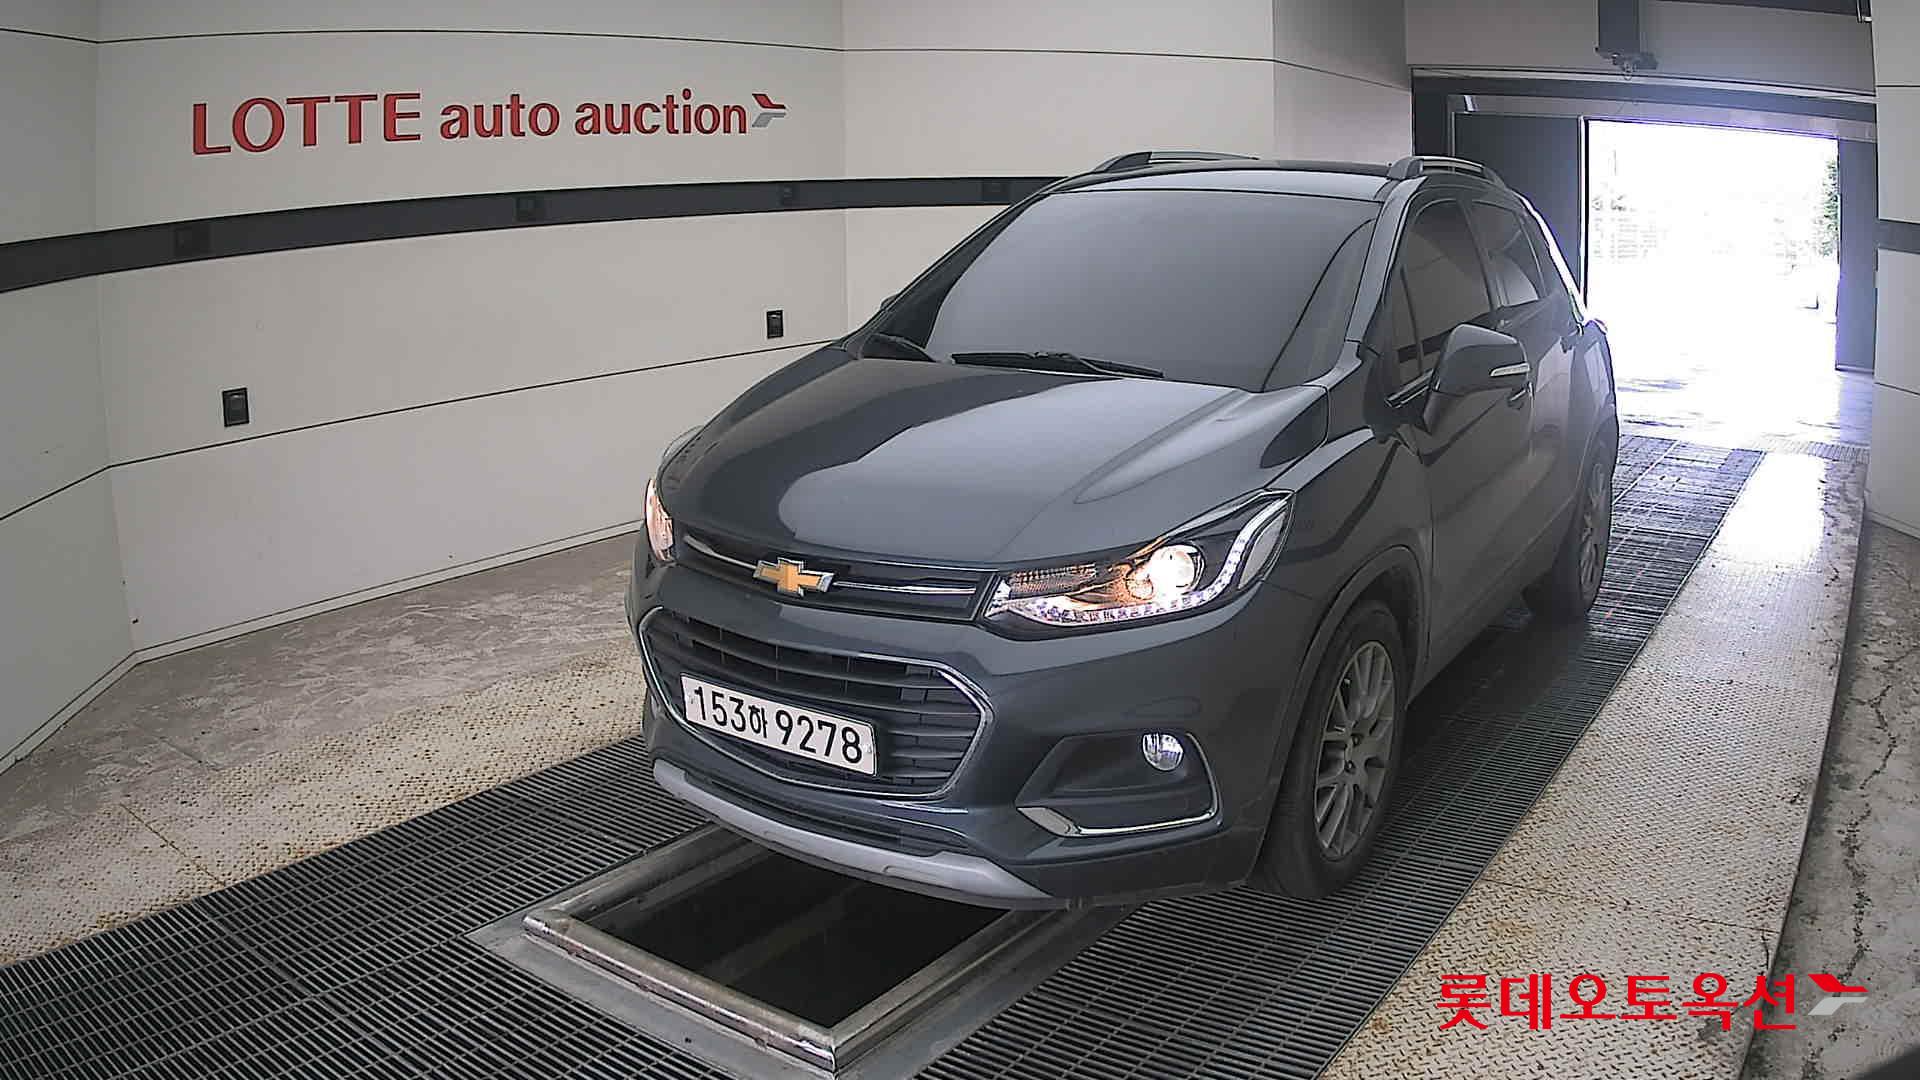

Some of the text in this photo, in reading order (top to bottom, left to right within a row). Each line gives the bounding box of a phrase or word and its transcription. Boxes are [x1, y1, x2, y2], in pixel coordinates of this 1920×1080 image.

[192, 88, 750, 156] LOTTE auto auction
